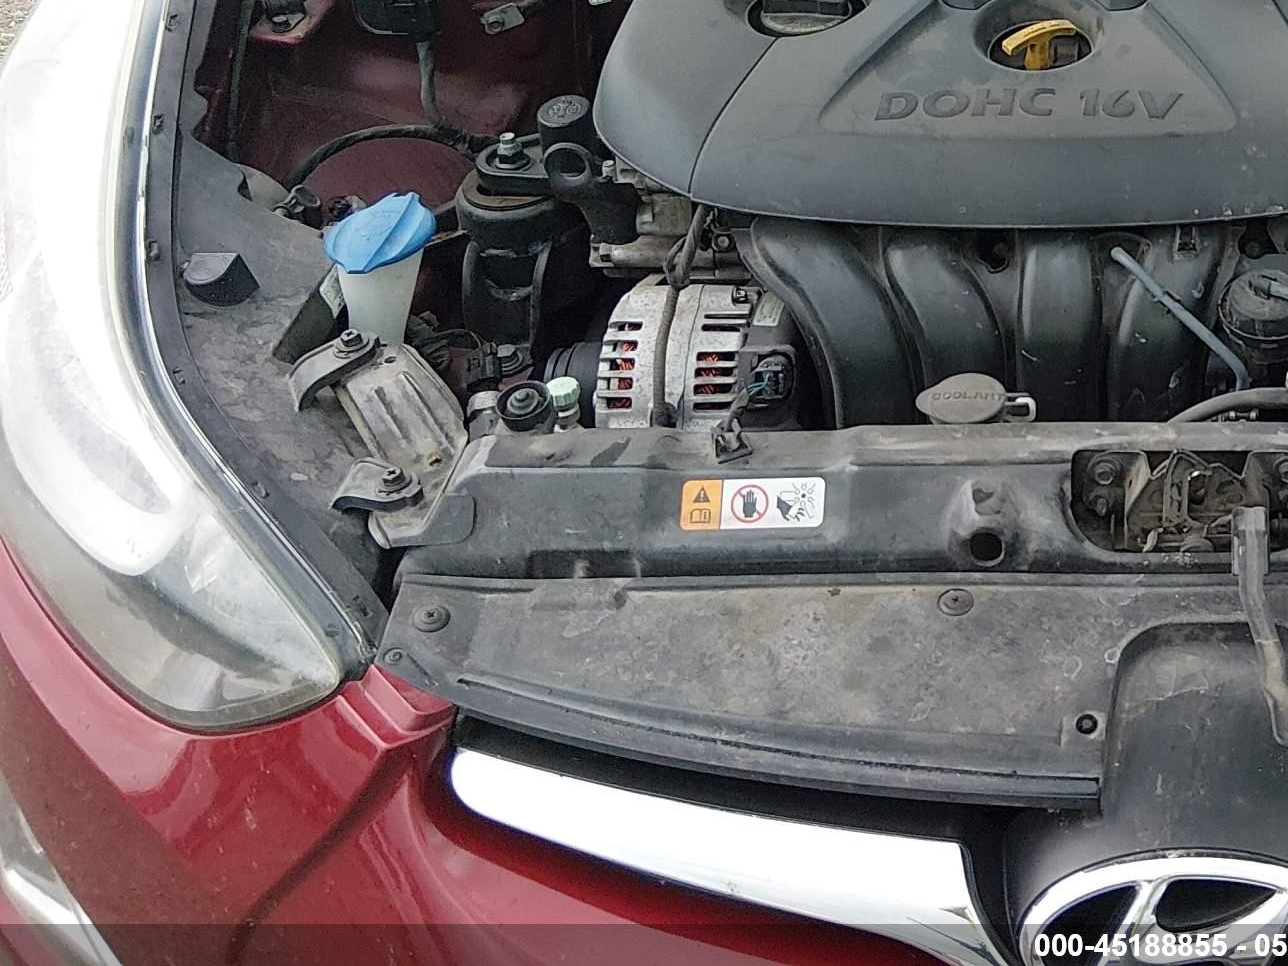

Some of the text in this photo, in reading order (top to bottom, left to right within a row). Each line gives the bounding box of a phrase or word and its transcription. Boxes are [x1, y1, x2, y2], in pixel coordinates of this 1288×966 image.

[874, 87, 1184, 121] DOHC 16V
[931, 390, 1007, 402] COOLANT
